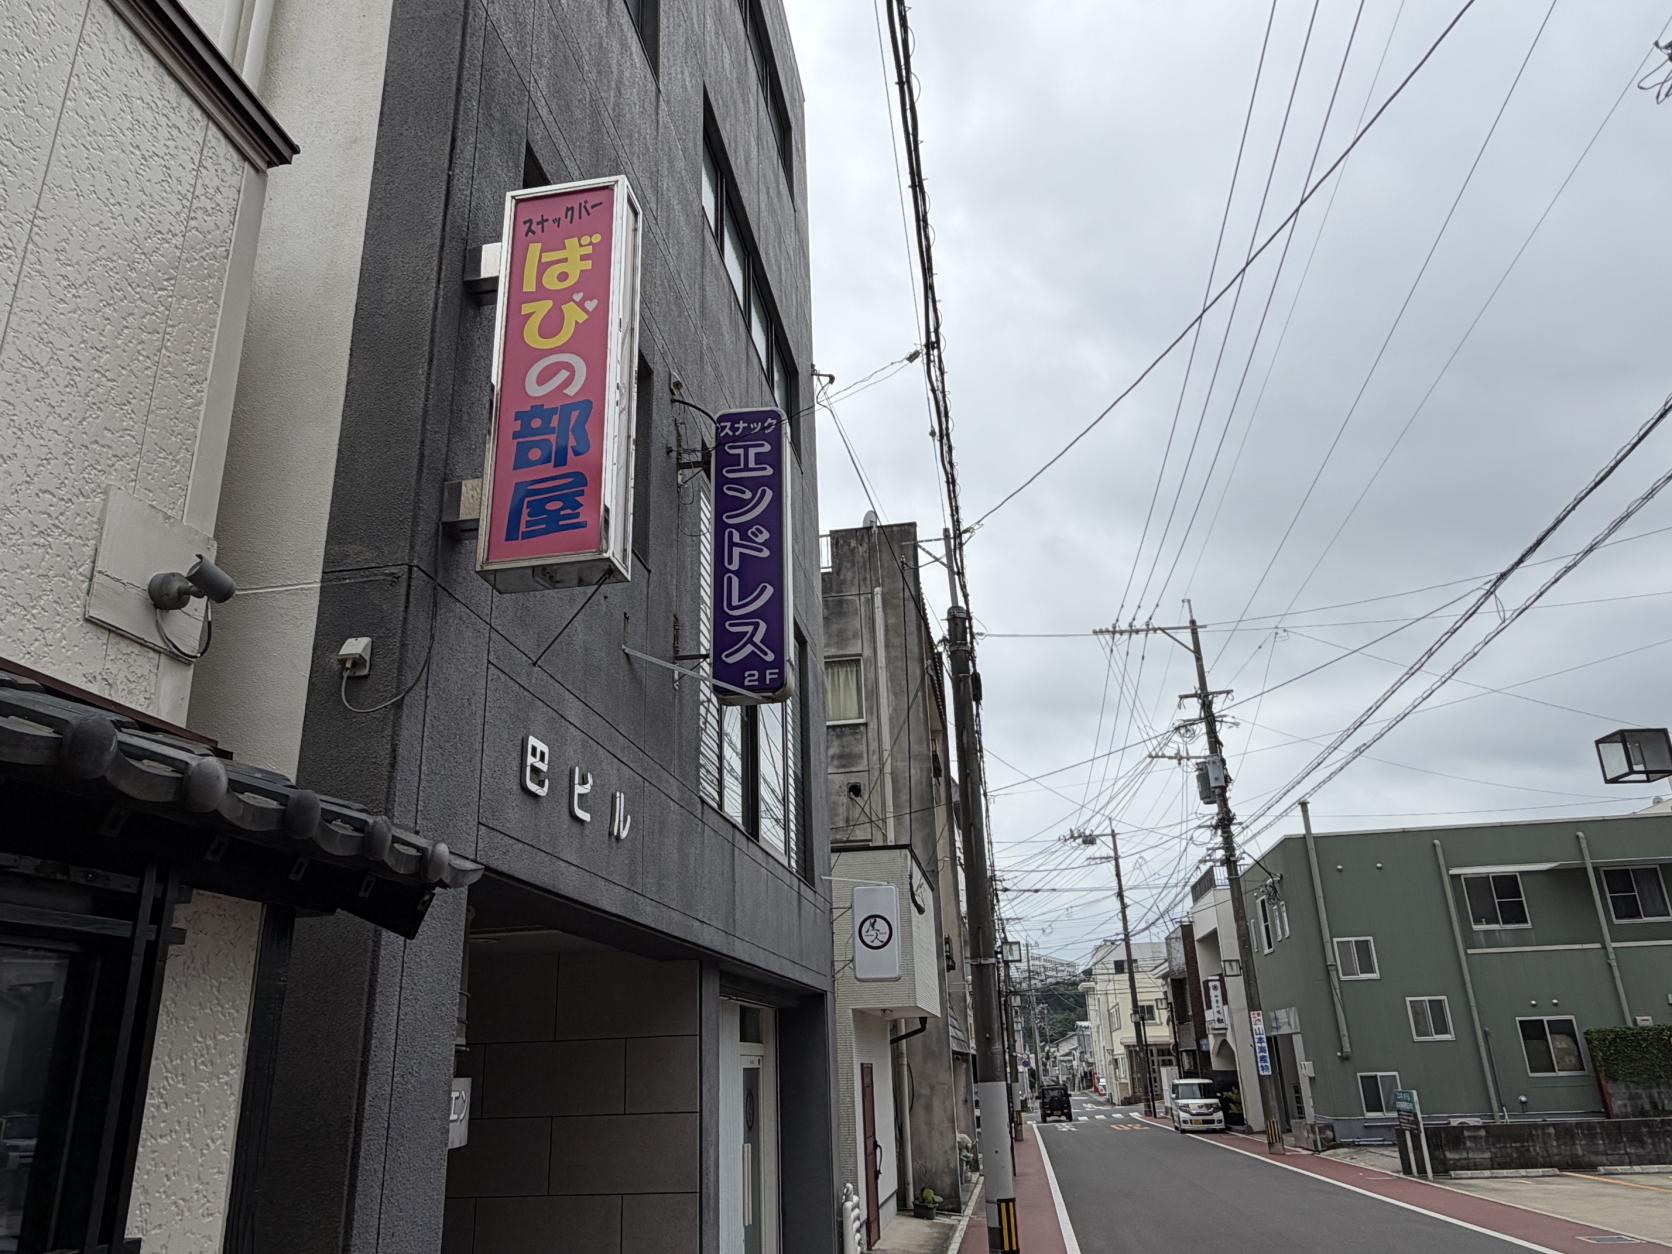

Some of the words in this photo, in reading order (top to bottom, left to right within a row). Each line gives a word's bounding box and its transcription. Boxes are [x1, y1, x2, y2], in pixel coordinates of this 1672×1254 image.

[523, 200, 603, 237] スナックバー
[505, 233, 602, 542] ばびの部屋
[720, 418, 777, 437] スナック
[721, 441, 776, 664] エンドレス
[744, 669, 779, 686] 2F
